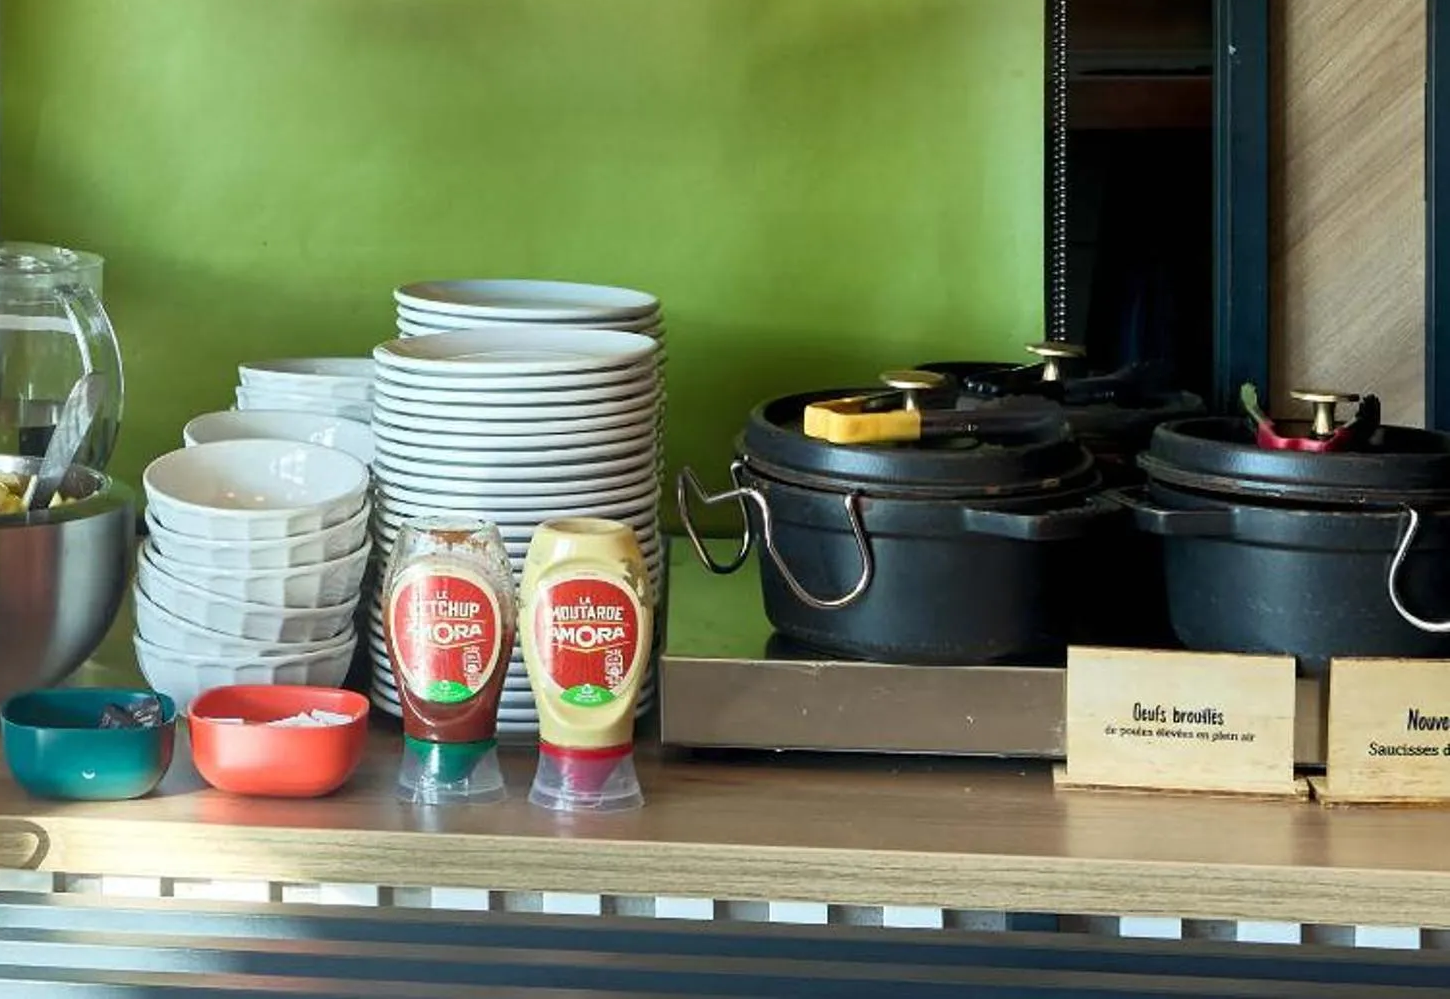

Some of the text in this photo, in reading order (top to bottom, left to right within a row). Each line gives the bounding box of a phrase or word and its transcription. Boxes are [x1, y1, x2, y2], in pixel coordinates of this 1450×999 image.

[551, 605, 625, 621] MOUTARDE
[550, 625, 625, 648] AMORA
[1132, 702, 1167, 723] Oeufs
[1368, 741, 1439, 756] Saucisses
